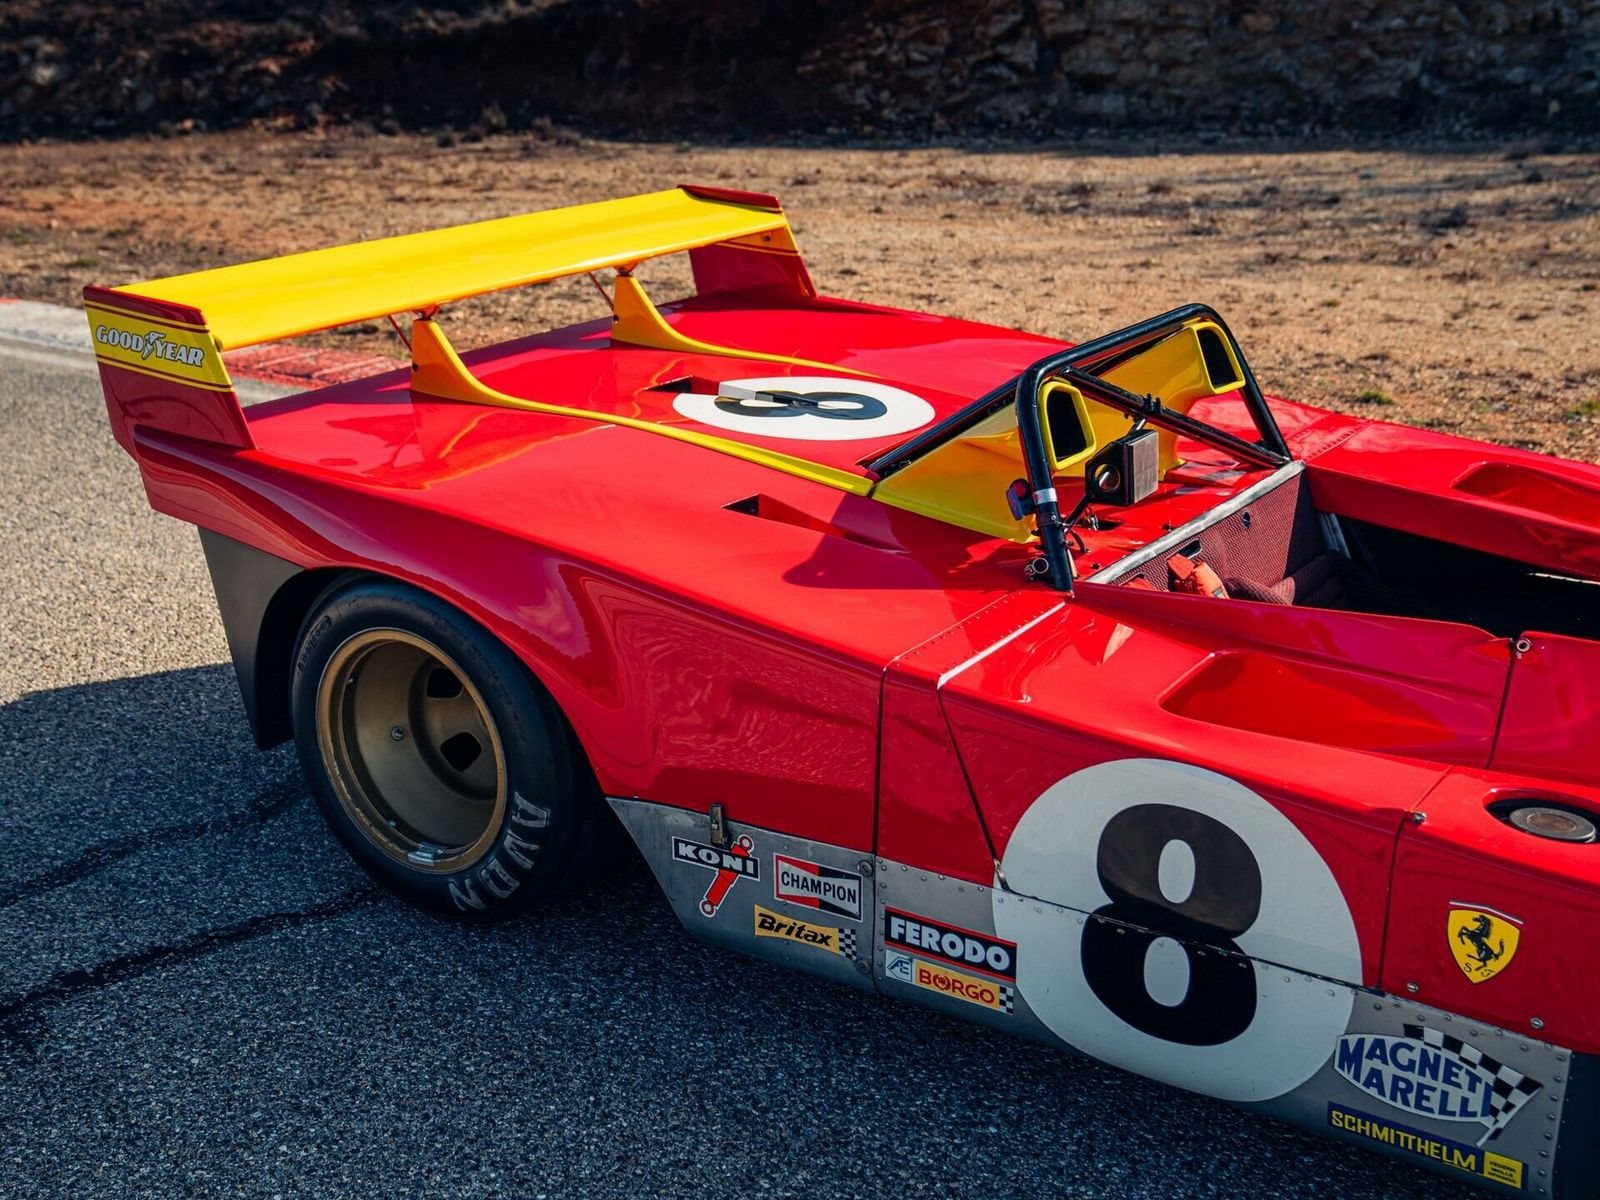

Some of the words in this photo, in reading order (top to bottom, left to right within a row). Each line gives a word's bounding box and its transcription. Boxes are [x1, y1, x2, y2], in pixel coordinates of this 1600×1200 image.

[449, 791, 551, 911] AVON
[678, 841, 754, 875] KONI
[781, 869, 857, 904] CHAMPION
[757, 911, 832, 947] Britax
[890, 915, 1010, 970] FERODO
[1081, 803, 1262, 1046] 8
[919, 968, 995, 1004] BORGO
[1337, 1037, 1493, 1105] MAGNETI
[1337, 1050, 1493, 1118] MARELLI
[1331, 1110, 1476, 1171] SCHMITTHELM
